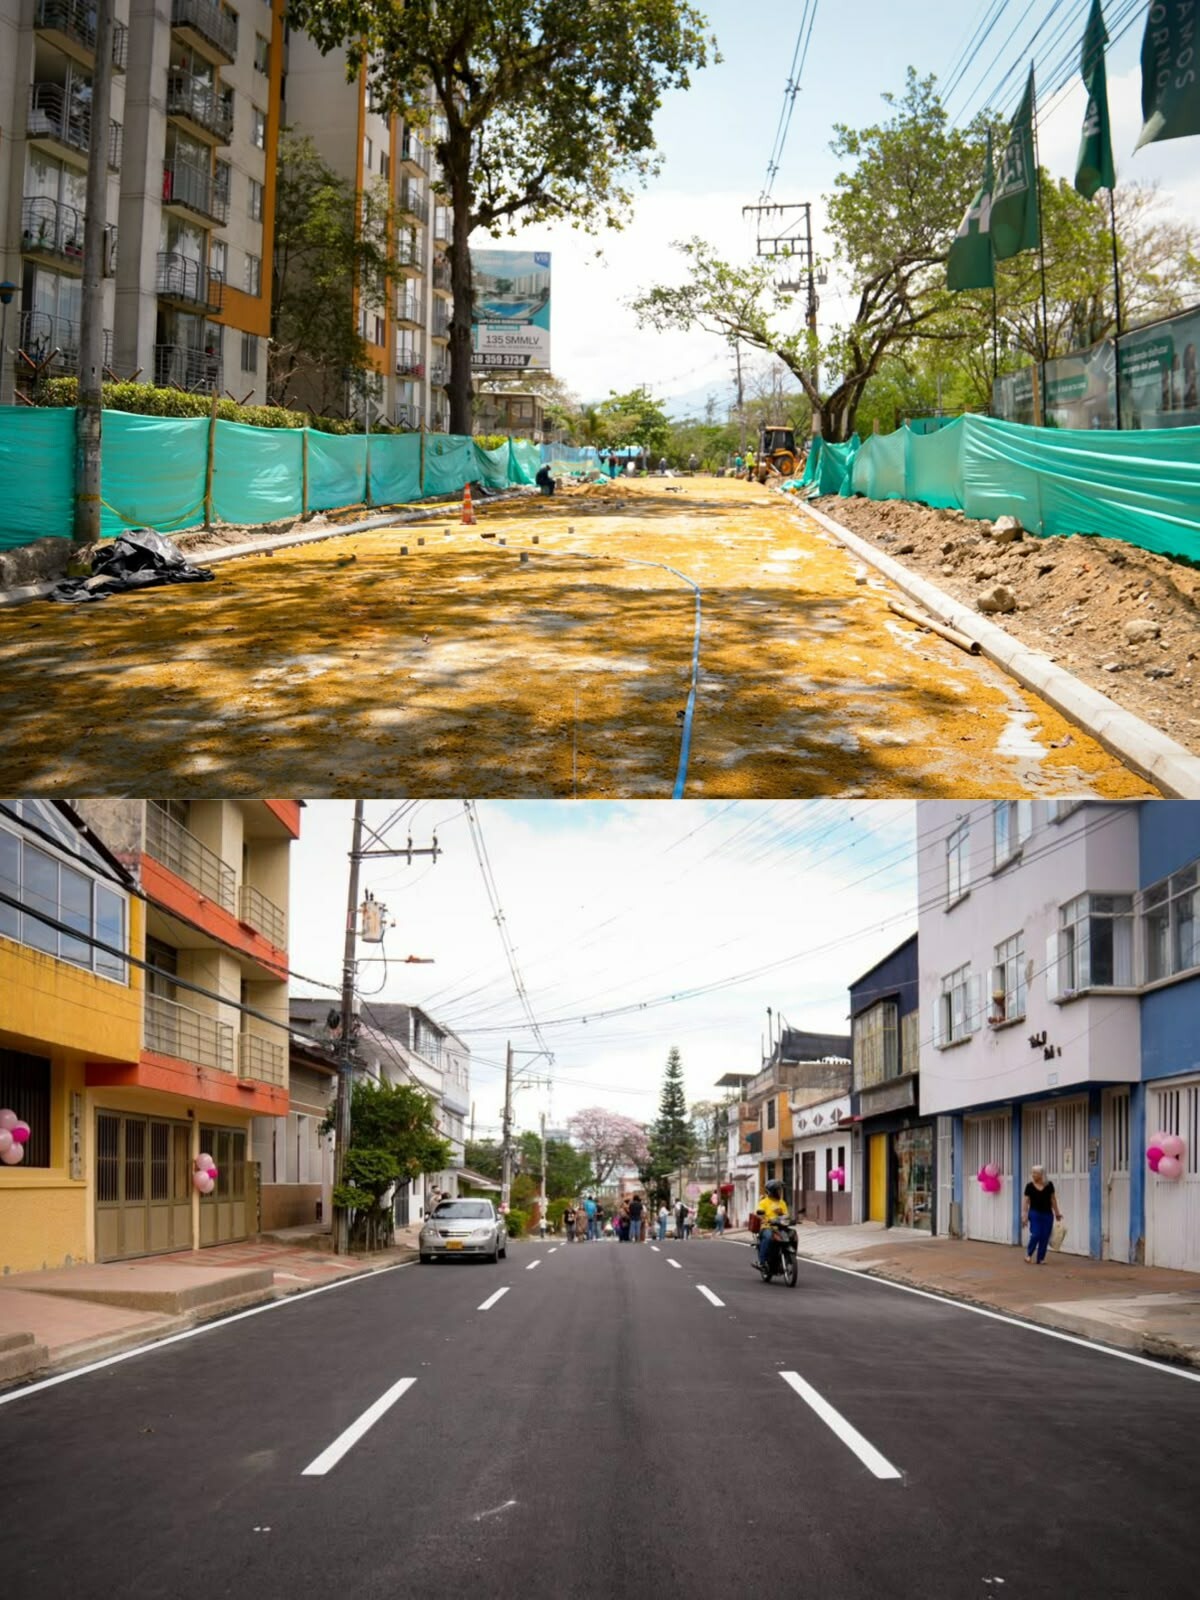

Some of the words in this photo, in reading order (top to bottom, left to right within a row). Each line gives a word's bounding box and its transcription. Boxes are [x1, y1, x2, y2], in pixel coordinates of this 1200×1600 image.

[486, 335, 504, 344] 135
[505, 335, 540, 345] SMMLV
[471, 354, 484, 364] 18
[485, 354, 503, 364] 359
[504, 355, 525, 365] 3734
